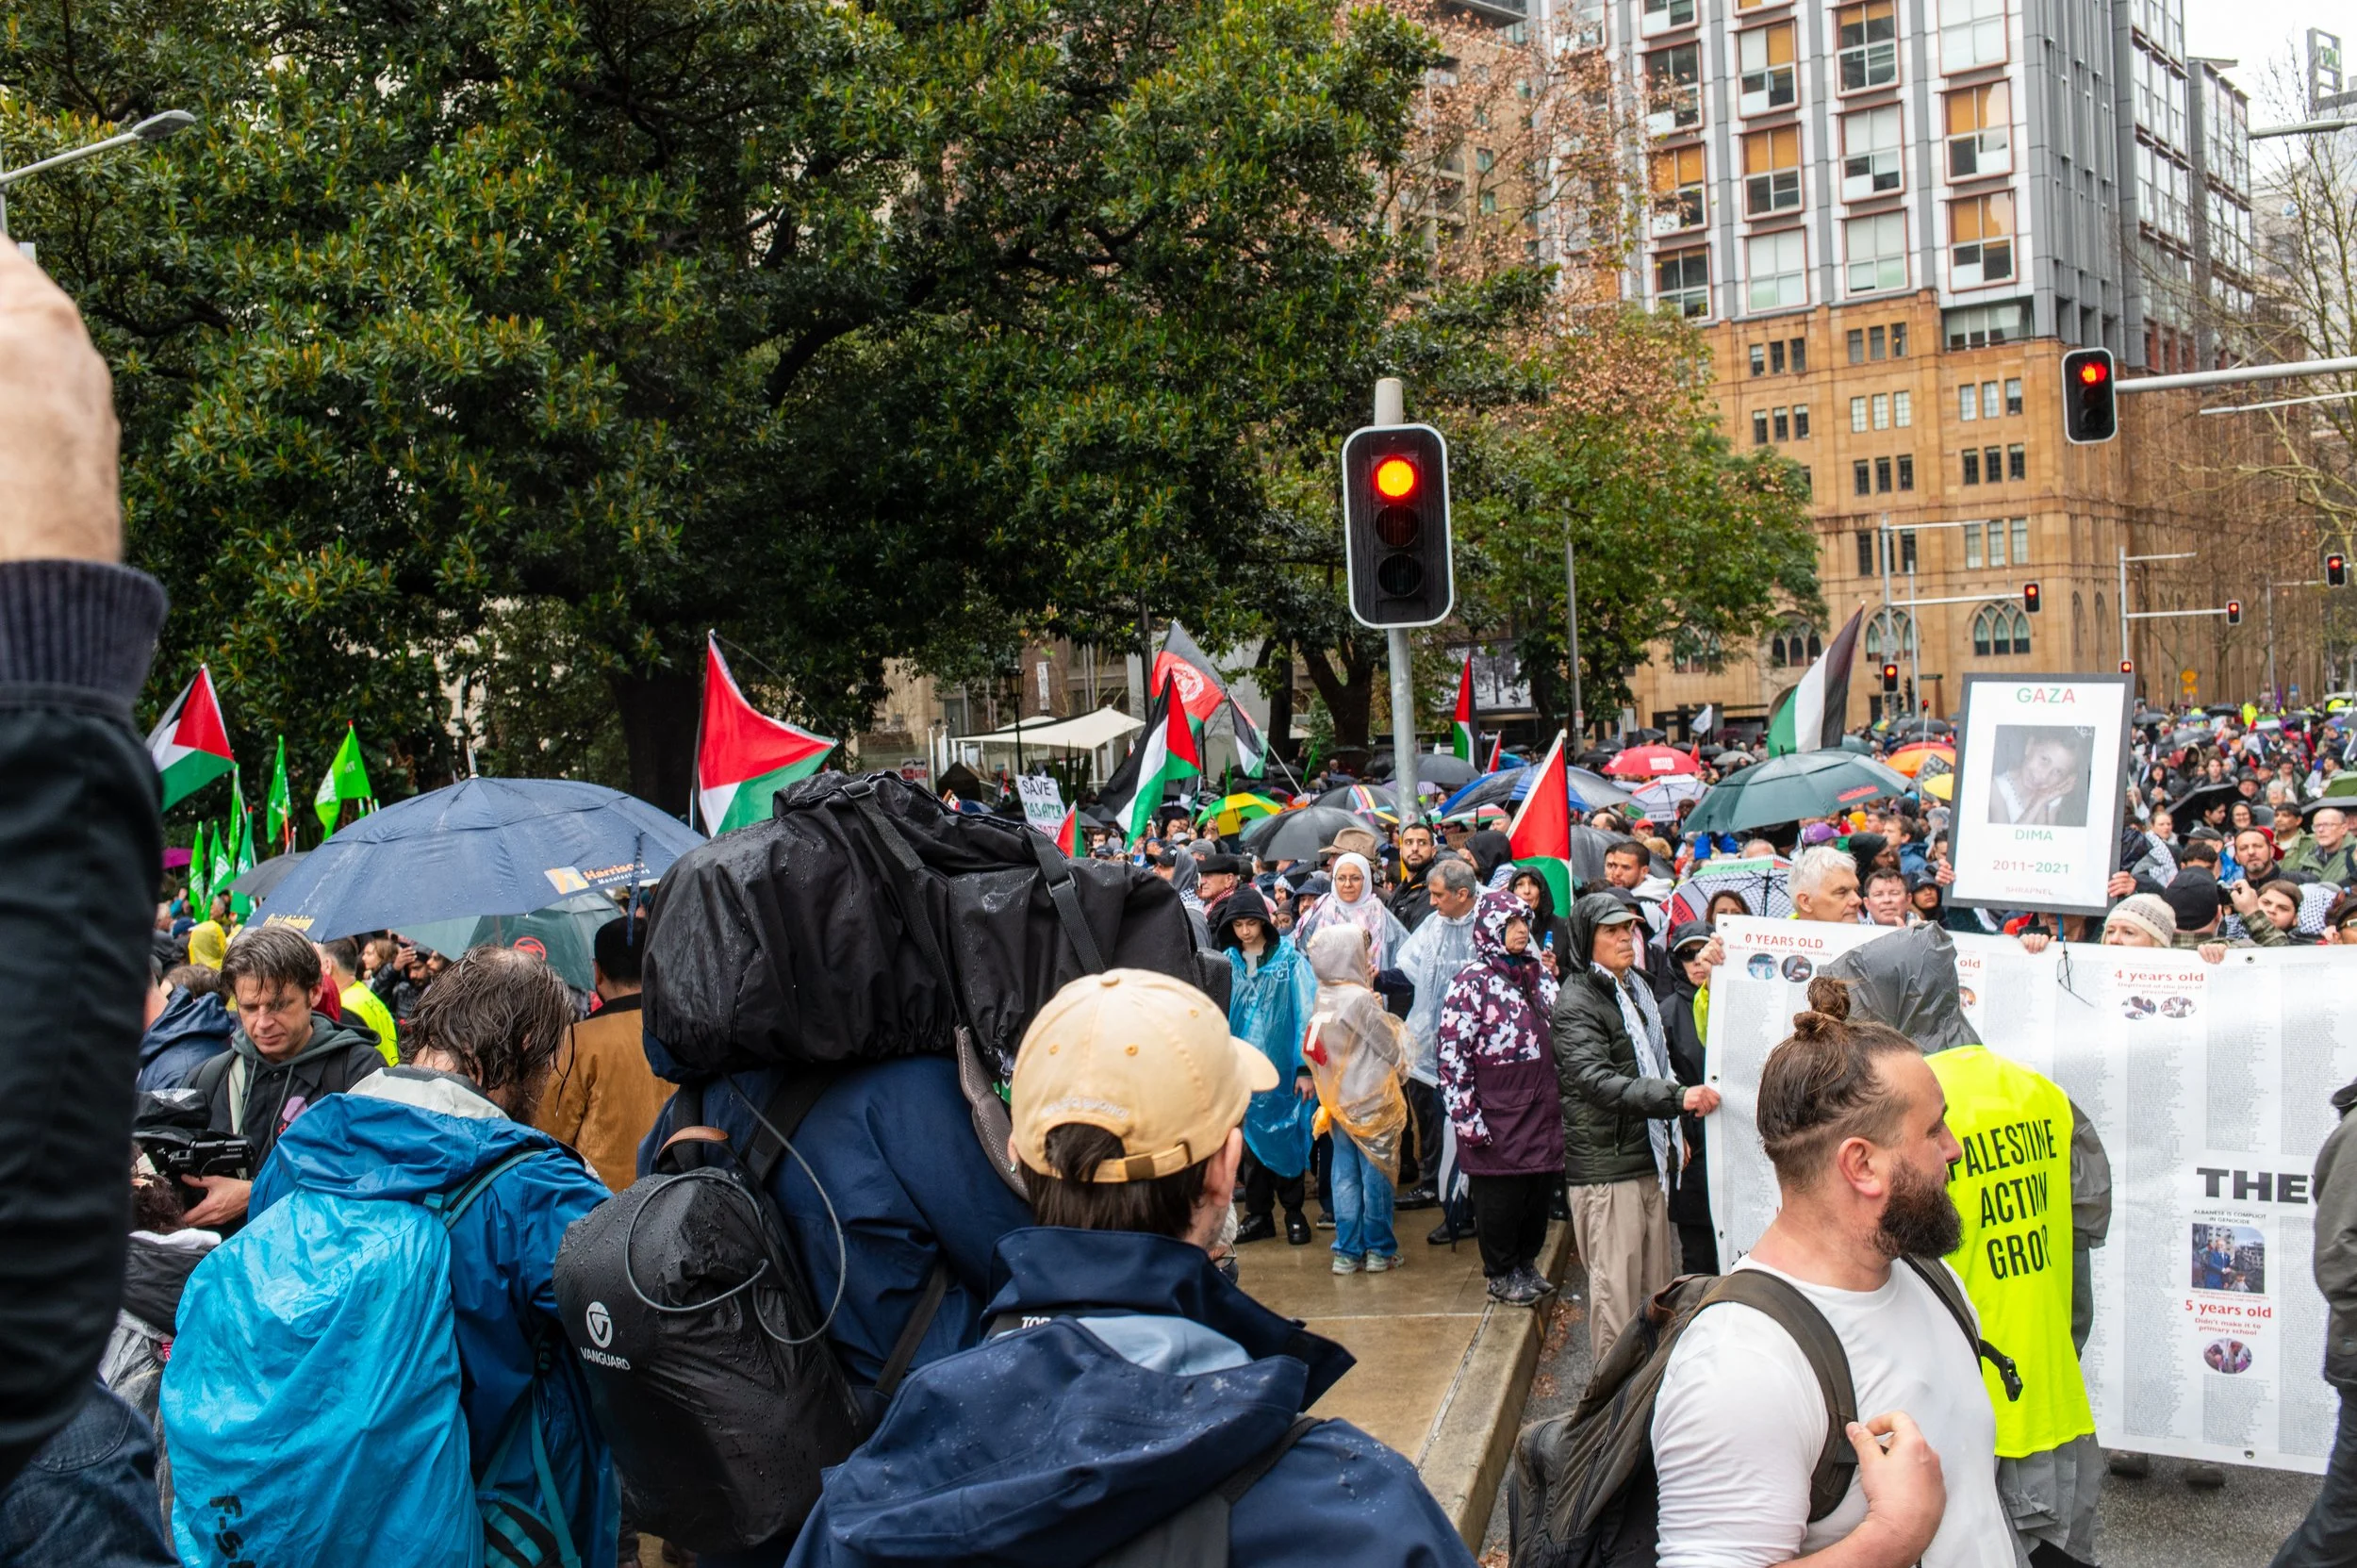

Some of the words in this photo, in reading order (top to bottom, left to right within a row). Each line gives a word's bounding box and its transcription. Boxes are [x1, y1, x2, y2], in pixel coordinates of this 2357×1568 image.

[2016, 686, 2076, 704] GAZA
[1022, 780, 1051, 796] SAVE
[2015, 829, 2053, 841] DIMA
[1992, 859, 2069, 874] 2011-2021
[1745, 933, 1752, 944] 0
[1755, 934, 1794, 947] YEARS
[1798, 937, 1823, 949] OLD
[1959, 958, 1981, 969] old
[2115, 969, 2122, 980] 4
[2130, 972, 2172, 982] years
[2179, 972, 2204, 982] old
[2196, 1167, 2308, 1204] THE
[2184, 1299, 2193, 1311] 5
[2199, 1303, 2241, 1315] years
[2247, 1306, 2272, 1318] old
[2195, 1317, 2218, 1326] Didn't
[2221, 1319, 2242, 1328] make
[2244, 1320, 2250, 1329] it
[2199, 1326, 2230, 1335] primary
[580, 1346, 631, 1371] VANGUARD
[209, 1495, 256, 1568] F-S
